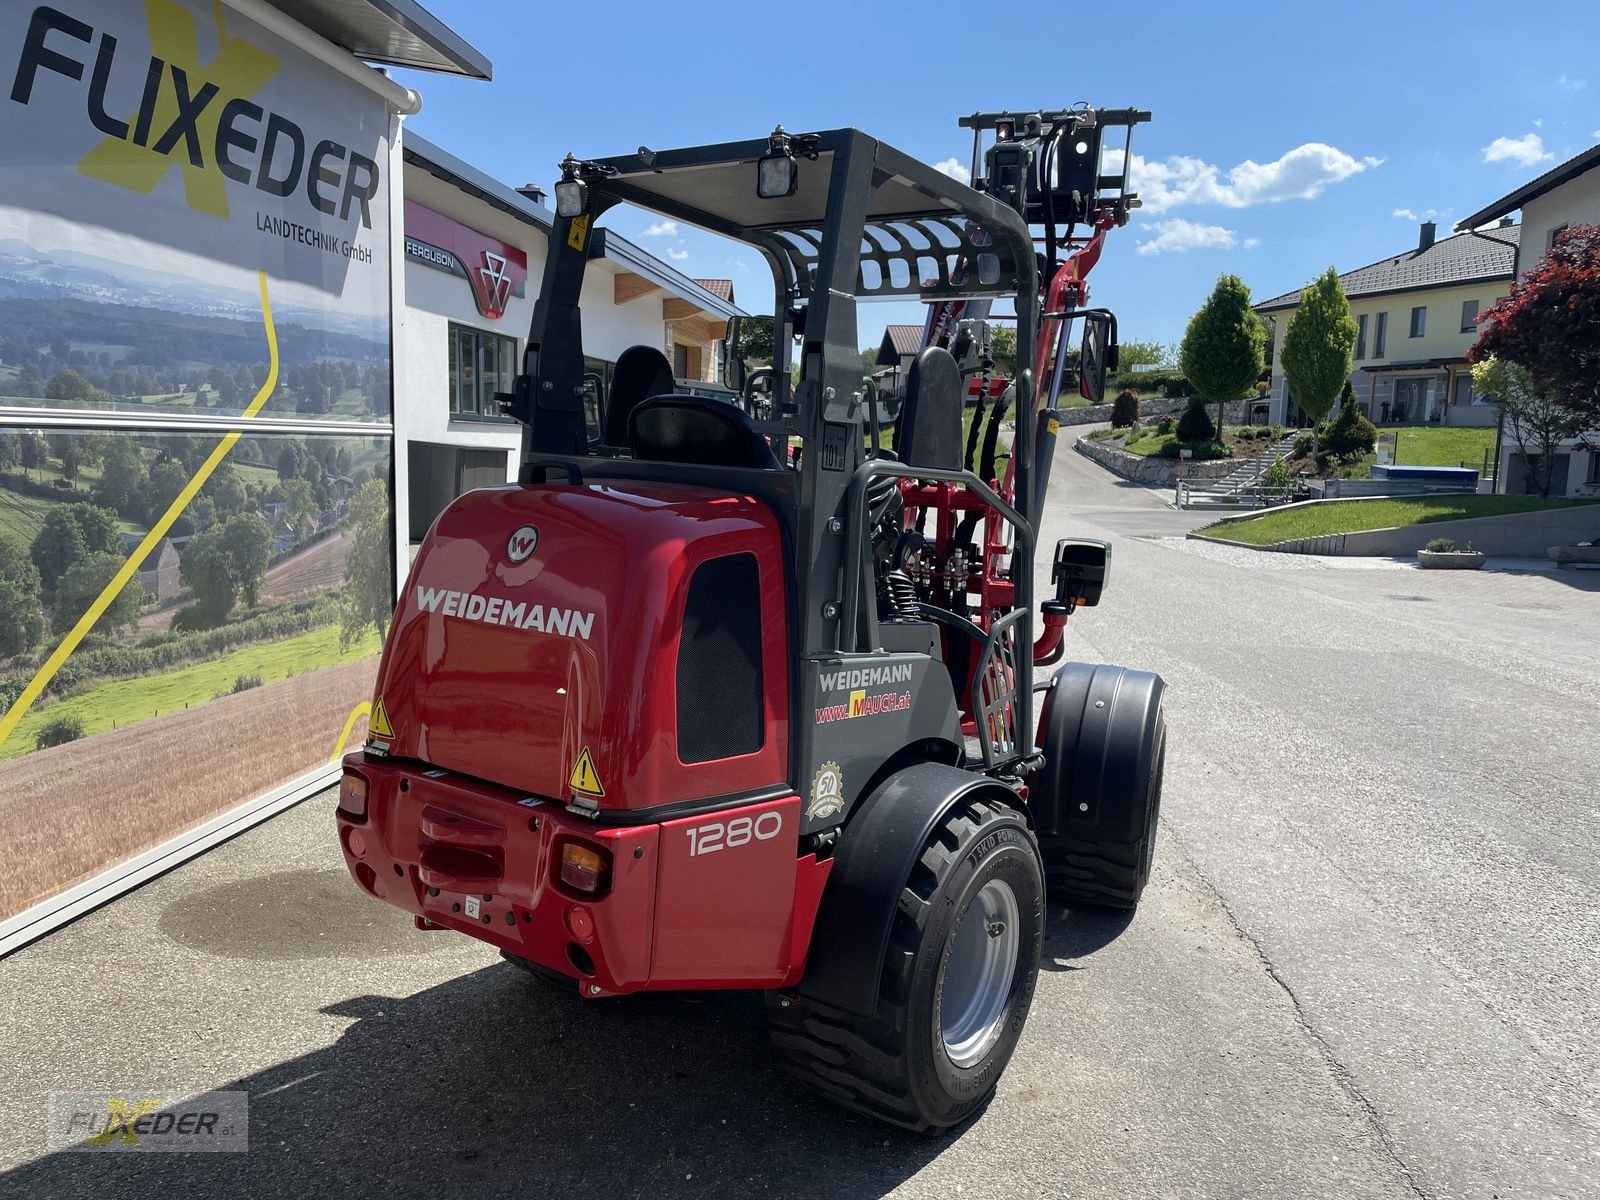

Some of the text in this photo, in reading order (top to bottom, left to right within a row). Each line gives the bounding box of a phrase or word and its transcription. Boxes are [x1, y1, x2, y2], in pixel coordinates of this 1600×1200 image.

[256, 211, 373, 265] LANDTECHNIK GmbH
[406, 242, 454, 268] FERGUSON
[417, 585, 595, 640] WEIDEMANN
[819, 664, 912, 693] WEIDEMANN
[820, 775, 835, 796] 50
[686, 811, 782, 857] 1280
[976, 829, 1021, 857] SKID POWE
